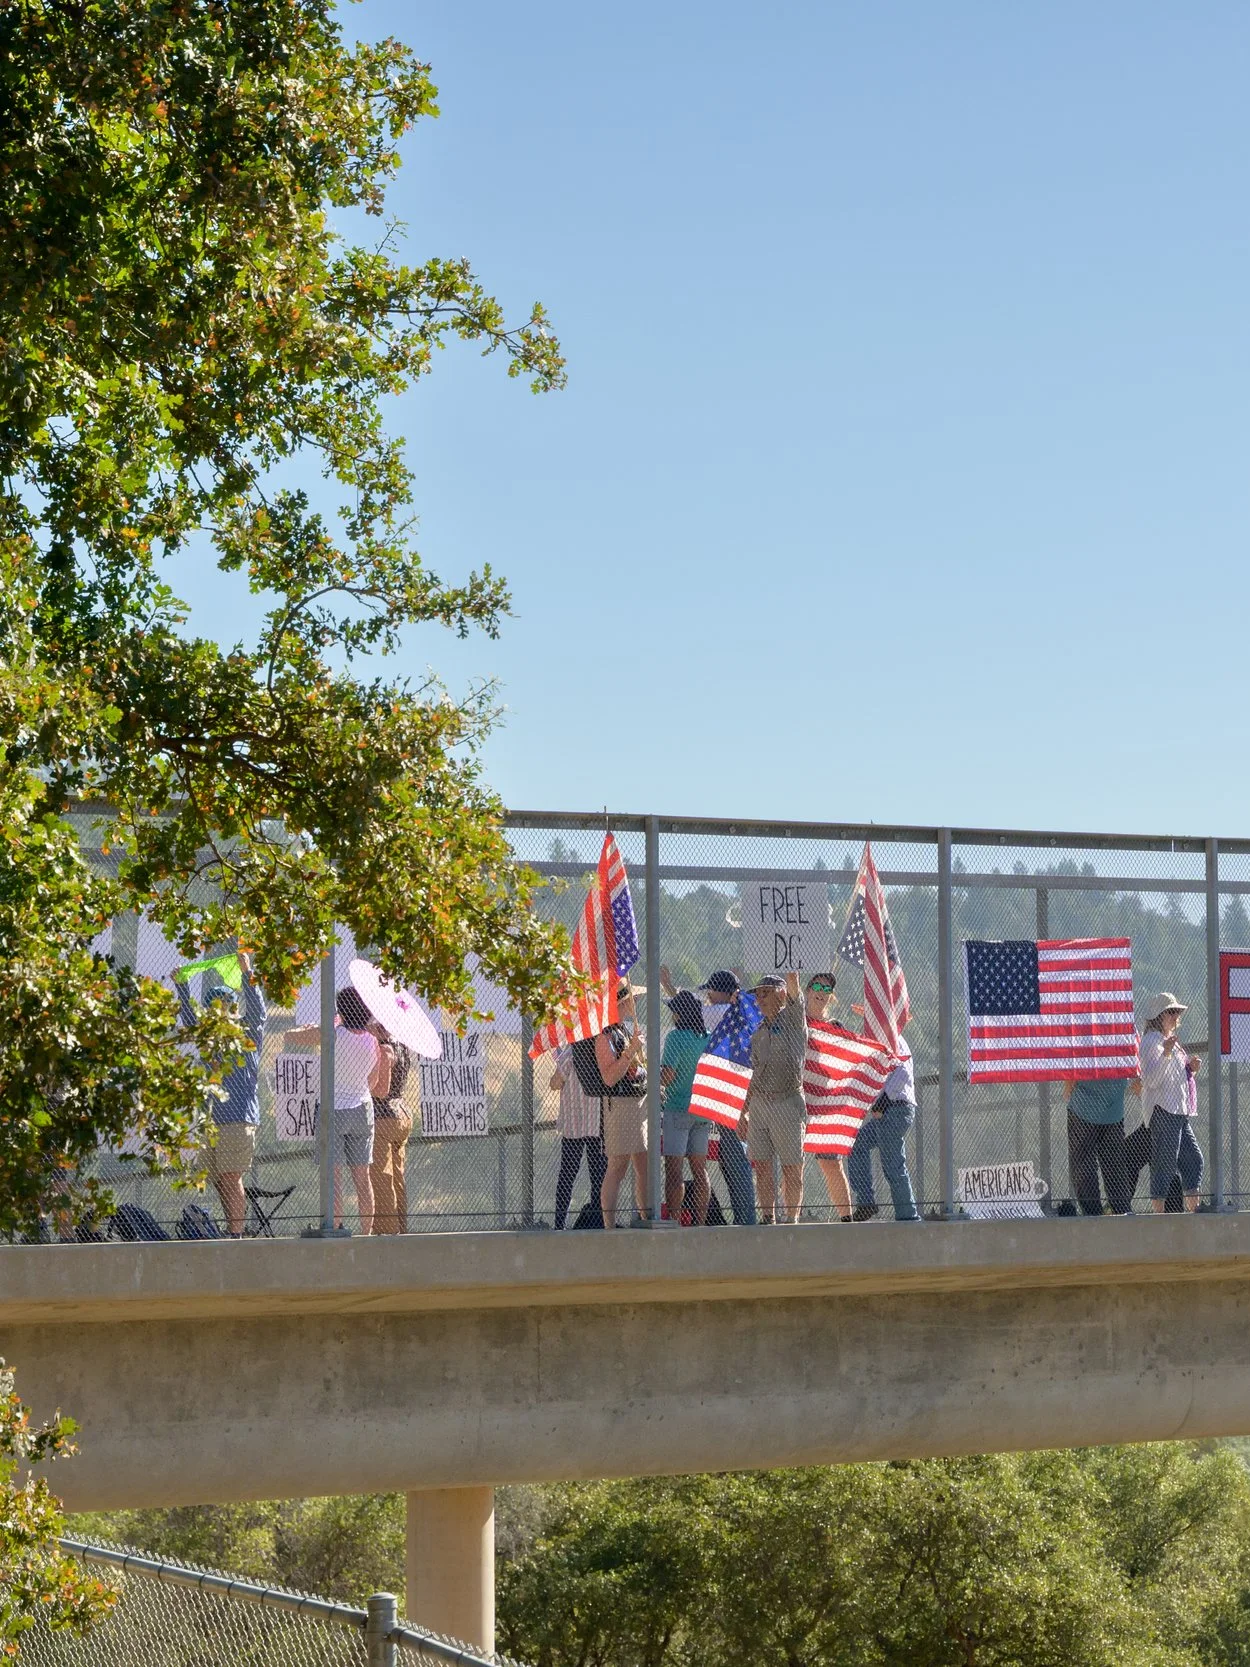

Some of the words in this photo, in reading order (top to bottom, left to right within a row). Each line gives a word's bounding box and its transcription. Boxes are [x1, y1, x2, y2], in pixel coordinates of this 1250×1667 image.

[759, 885, 810, 924] FREE
[275, 1058, 315, 1095] HOPE
[419, 1063, 486, 1097] TURNING
[285, 1097, 320, 1137] SAV
[463, 1101, 487, 1132] HIS
[963, 1166, 1032, 1201] AMERICANS
